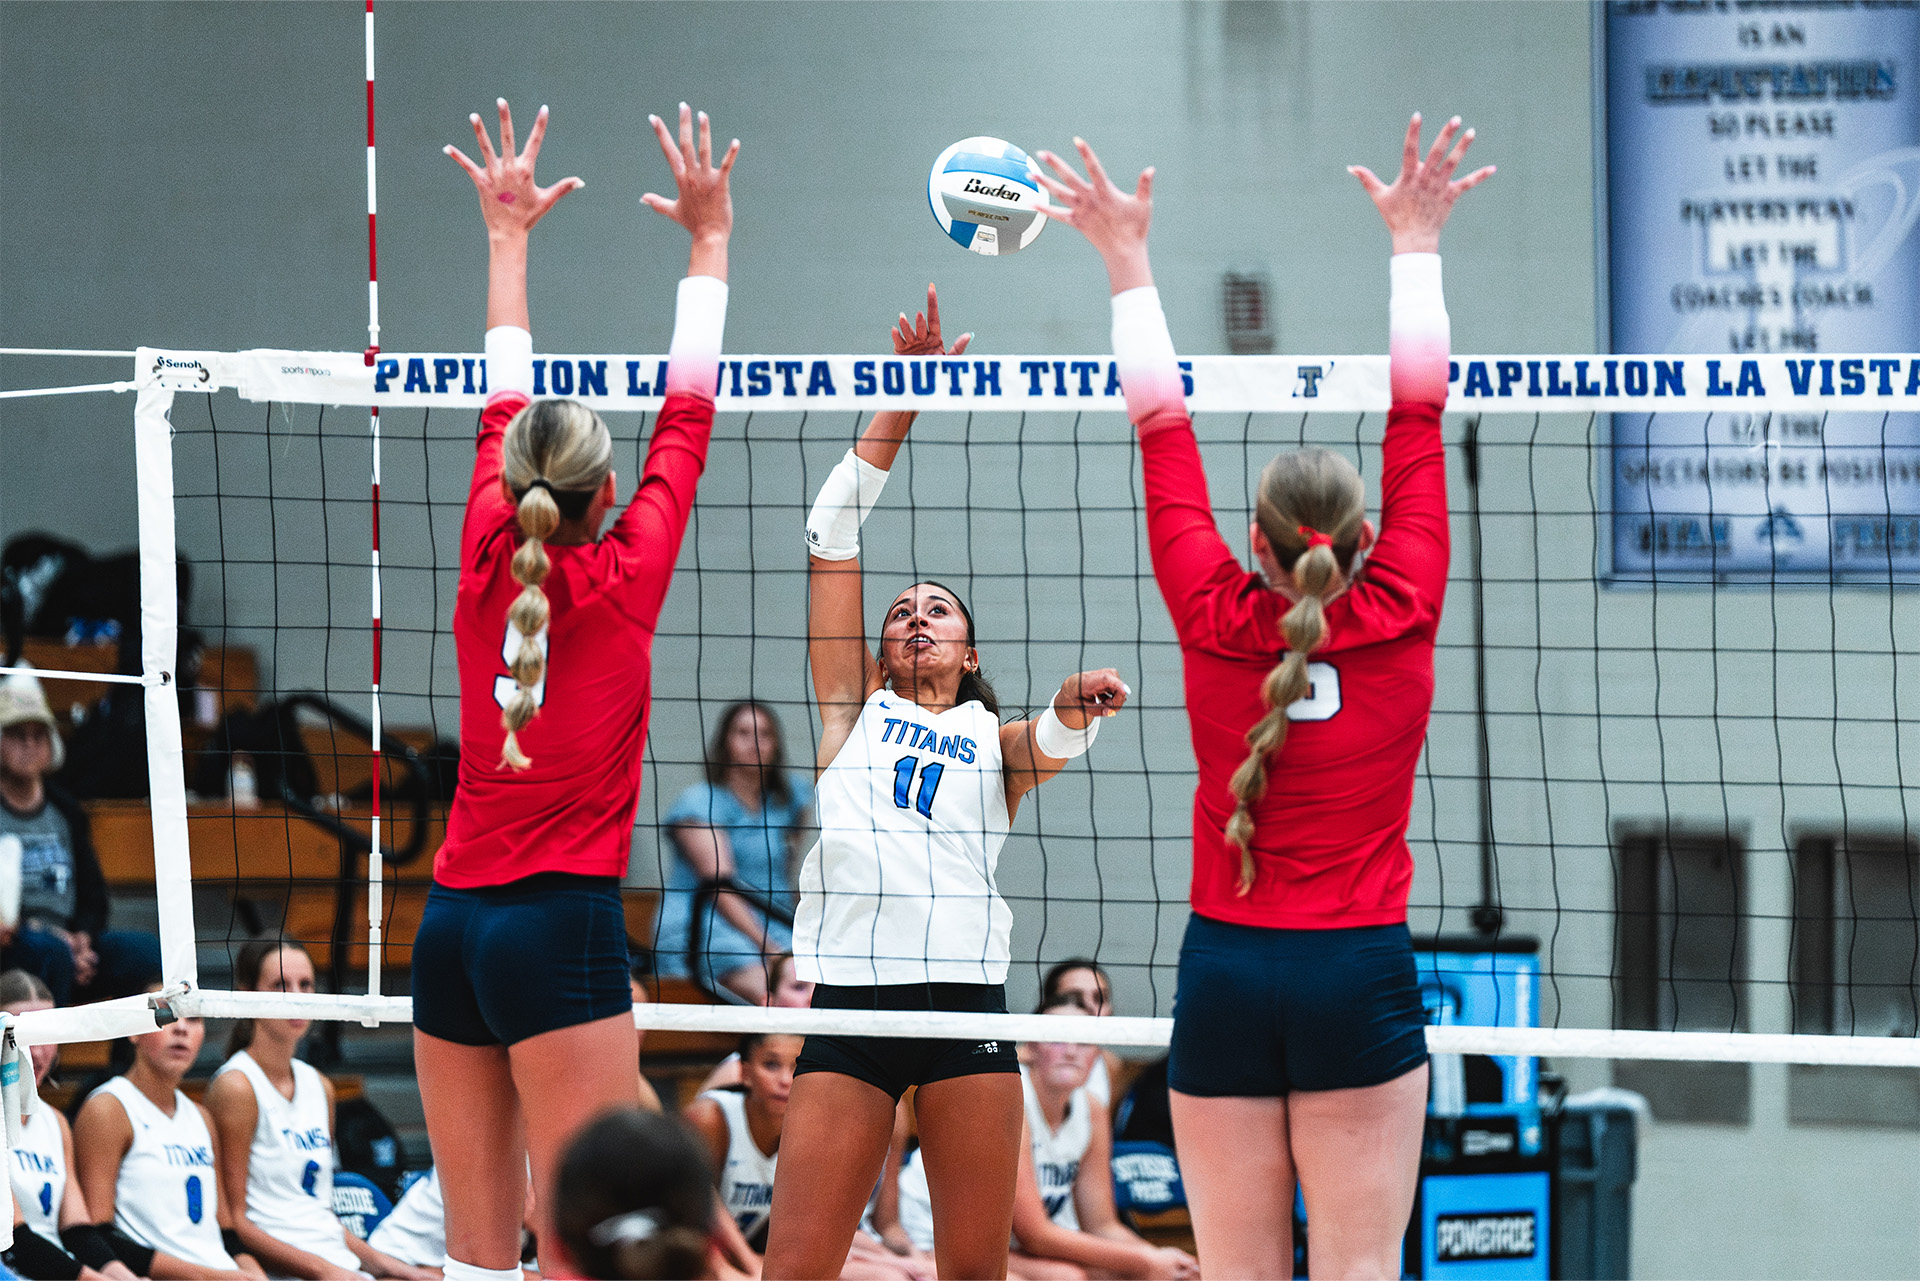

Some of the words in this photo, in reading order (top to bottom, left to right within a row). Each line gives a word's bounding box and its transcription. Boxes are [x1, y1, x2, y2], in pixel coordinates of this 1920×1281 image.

[1745, 112, 1836, 139] PLEASE
[1725, 154, 1767, 183] LET
[1777, 154, 1818, 183] THE
[964, 178, 1021, 202] Baden
[166, 359, 202, 369] Senoh
[374, 358, 609, 396] PAPIION
[716, 360, 837, 397] ISTA
[854, 361, 1001, 396] SOUTH
[1020, 361, 1194, 397] TITAS
[1706, 360, 1765, 396] LA
[881, 717, 978, 765] TITANS
[893, 754, 945, 821] 11
